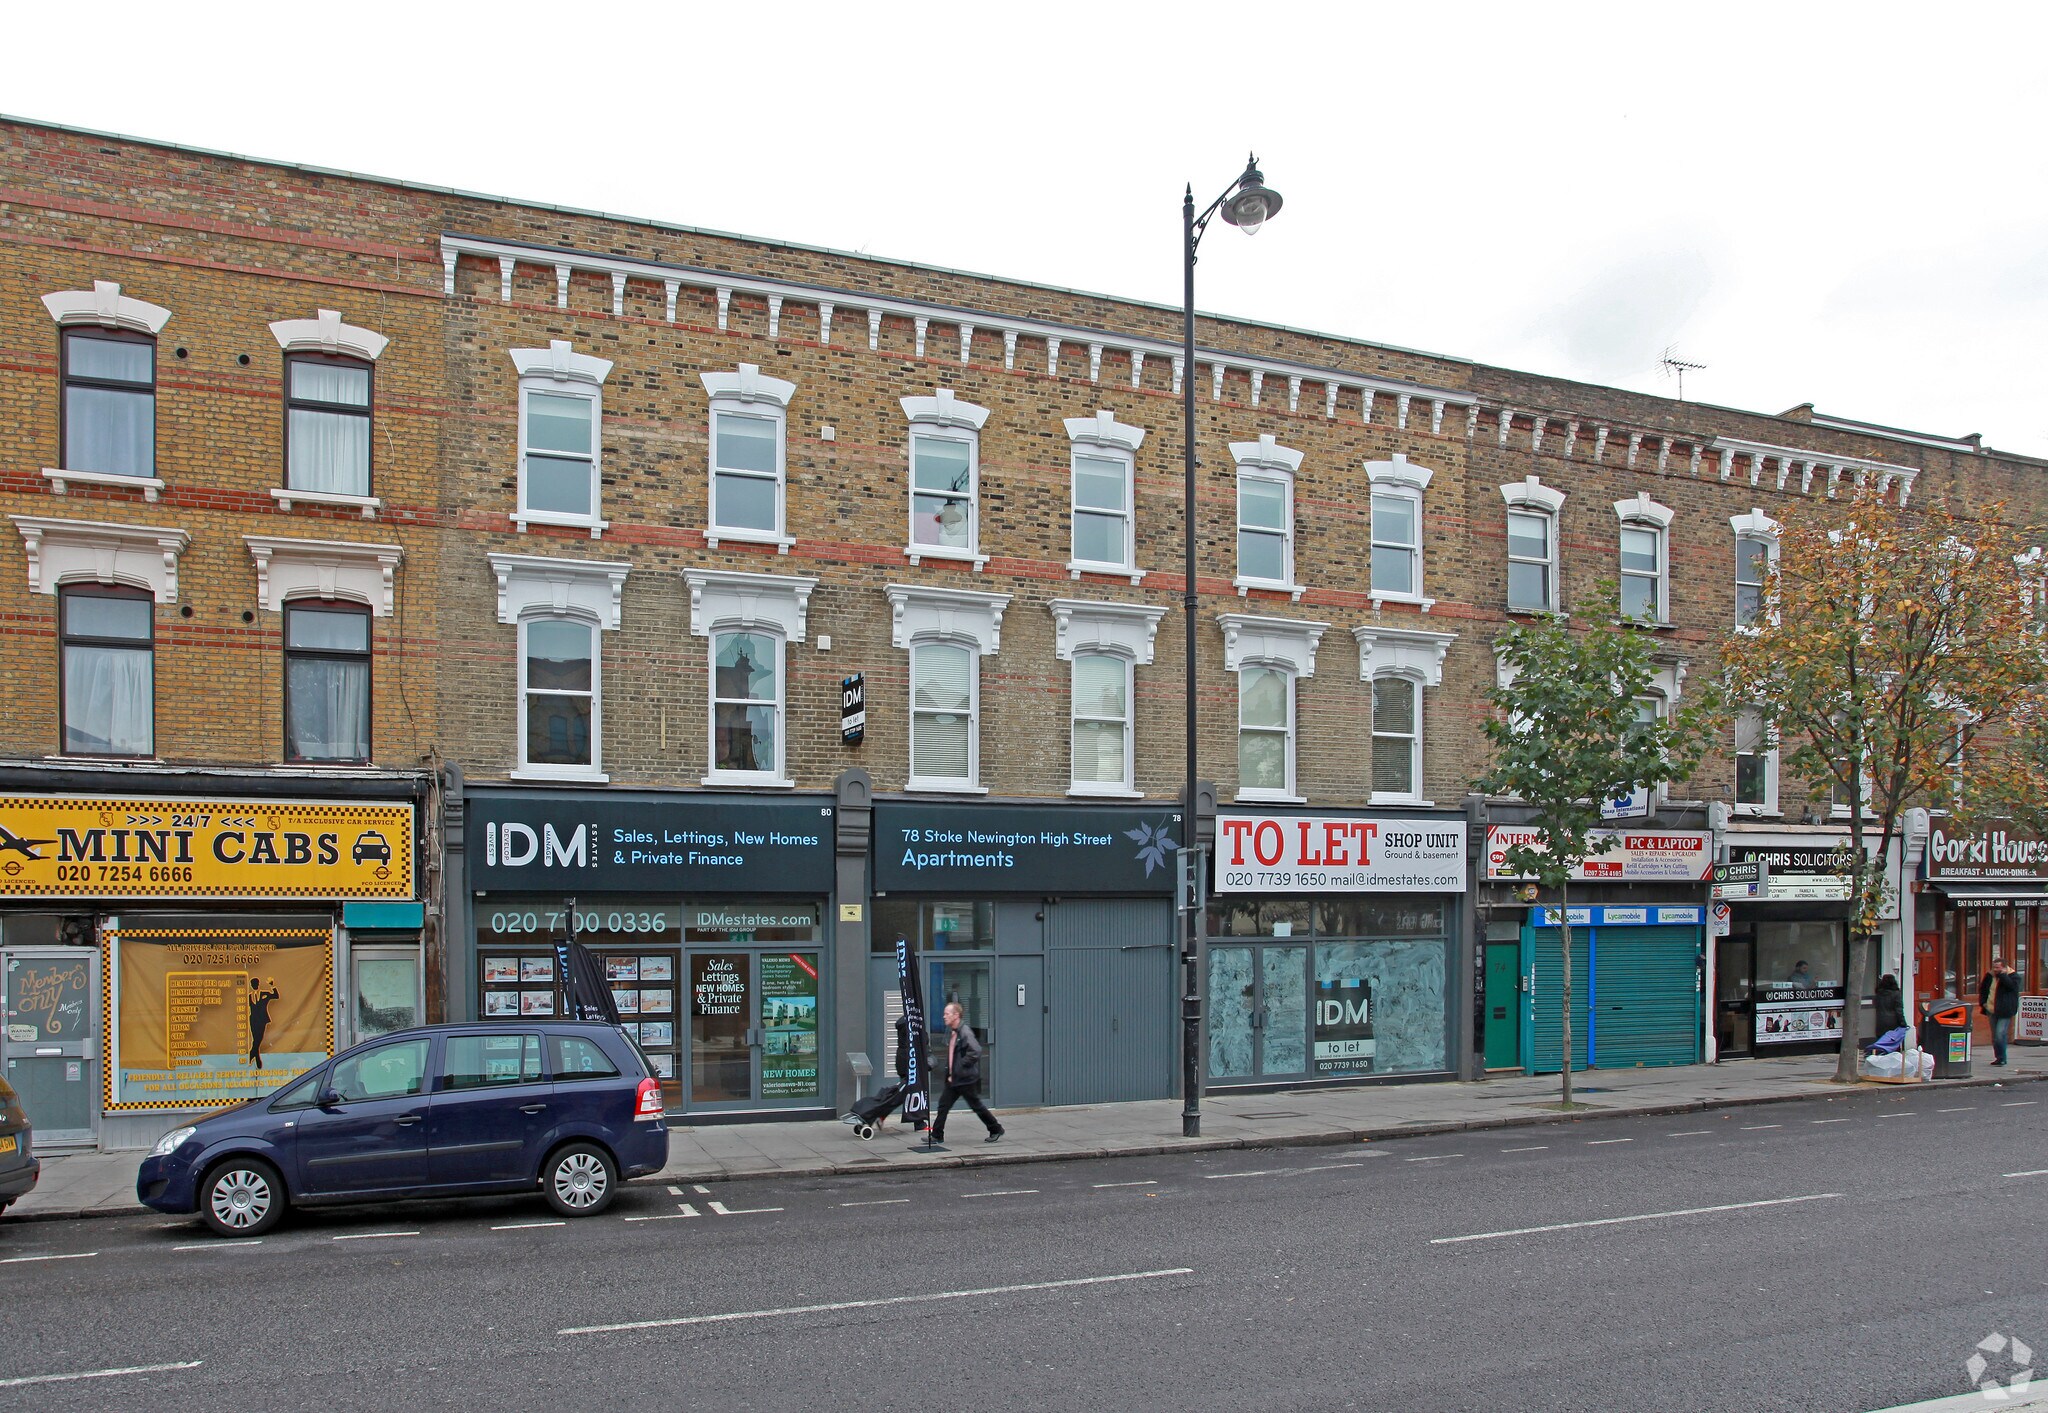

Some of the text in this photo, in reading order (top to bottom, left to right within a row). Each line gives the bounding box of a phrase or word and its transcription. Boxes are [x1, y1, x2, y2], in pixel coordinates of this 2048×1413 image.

[843, 686, 861, 708] IDM
[821, 808, 832, 816] 80
[1172, 814, 1181, 822] 78
[172, 814, 211, 827] 24/7
[613, 829, 818, 847] Sales, Lettings, New Homes
[901, 829, 1112, 846] 78 Stoke Newington High Street
[1223, 820, 1378, 866] TO LET
[1385, 833, 1458, 848] SHOP UNIT
[1630, 838, 1698, 850] PC & LAPTOP
[56, 828, 340, 865] MINI CABS
[486, 822, 587, 868] IDM
[1932, 830, 1987, 863] Gorki
[613, 851, 744, 865] & Private Finance
[901, 848, 1014, 870] Apartments
[1384, 850, 1458, 859] Ground & basement
[1758, 853, 1852, 866] CHRIS SOLICITORS
[57, 865, 193, 882] 020 7254 6666
[1730, 865, 1757, 874] CHRIS
[1941, 868, 1980, 876] BREAKFAST
[1226, 872, 1458, 886] 020 7739 1650 mail@idmestates.com
[491, 912, 538, 934] 020
[607, 912, 666, 934] 0336
[697, 912, 811, 926] IDMestates.com
[183, 954, 260, 964] 020 7254 6666
[707, 959, 733, 971] Sales
[701, 972, 740, 983] Lettings
[696, 984, 745, 992] NEW HOMES
[1773, 989, 1834, 1000] CHRIS SOLICITORS
[697, 993, 742, 1004] & Private
[701, 1004, 740, 1014] Finance
[1316, 999, 1368, 1026] IDM
[1328, 1041, 1360, 1053] to let
[128, 1073, 165, 1081] FRIENDLY
[176, 1071, 213, 1080] RELIABLE
[216, 1070, 247, 1079] SERVICE
[249, 1069, 288, 1078] BOOKINGS
[763, 1069, 815, 1078] NEW HOMES
[144, 1079, 264, 1092] FOR ALL OCCASIONS ACCOUNTS
